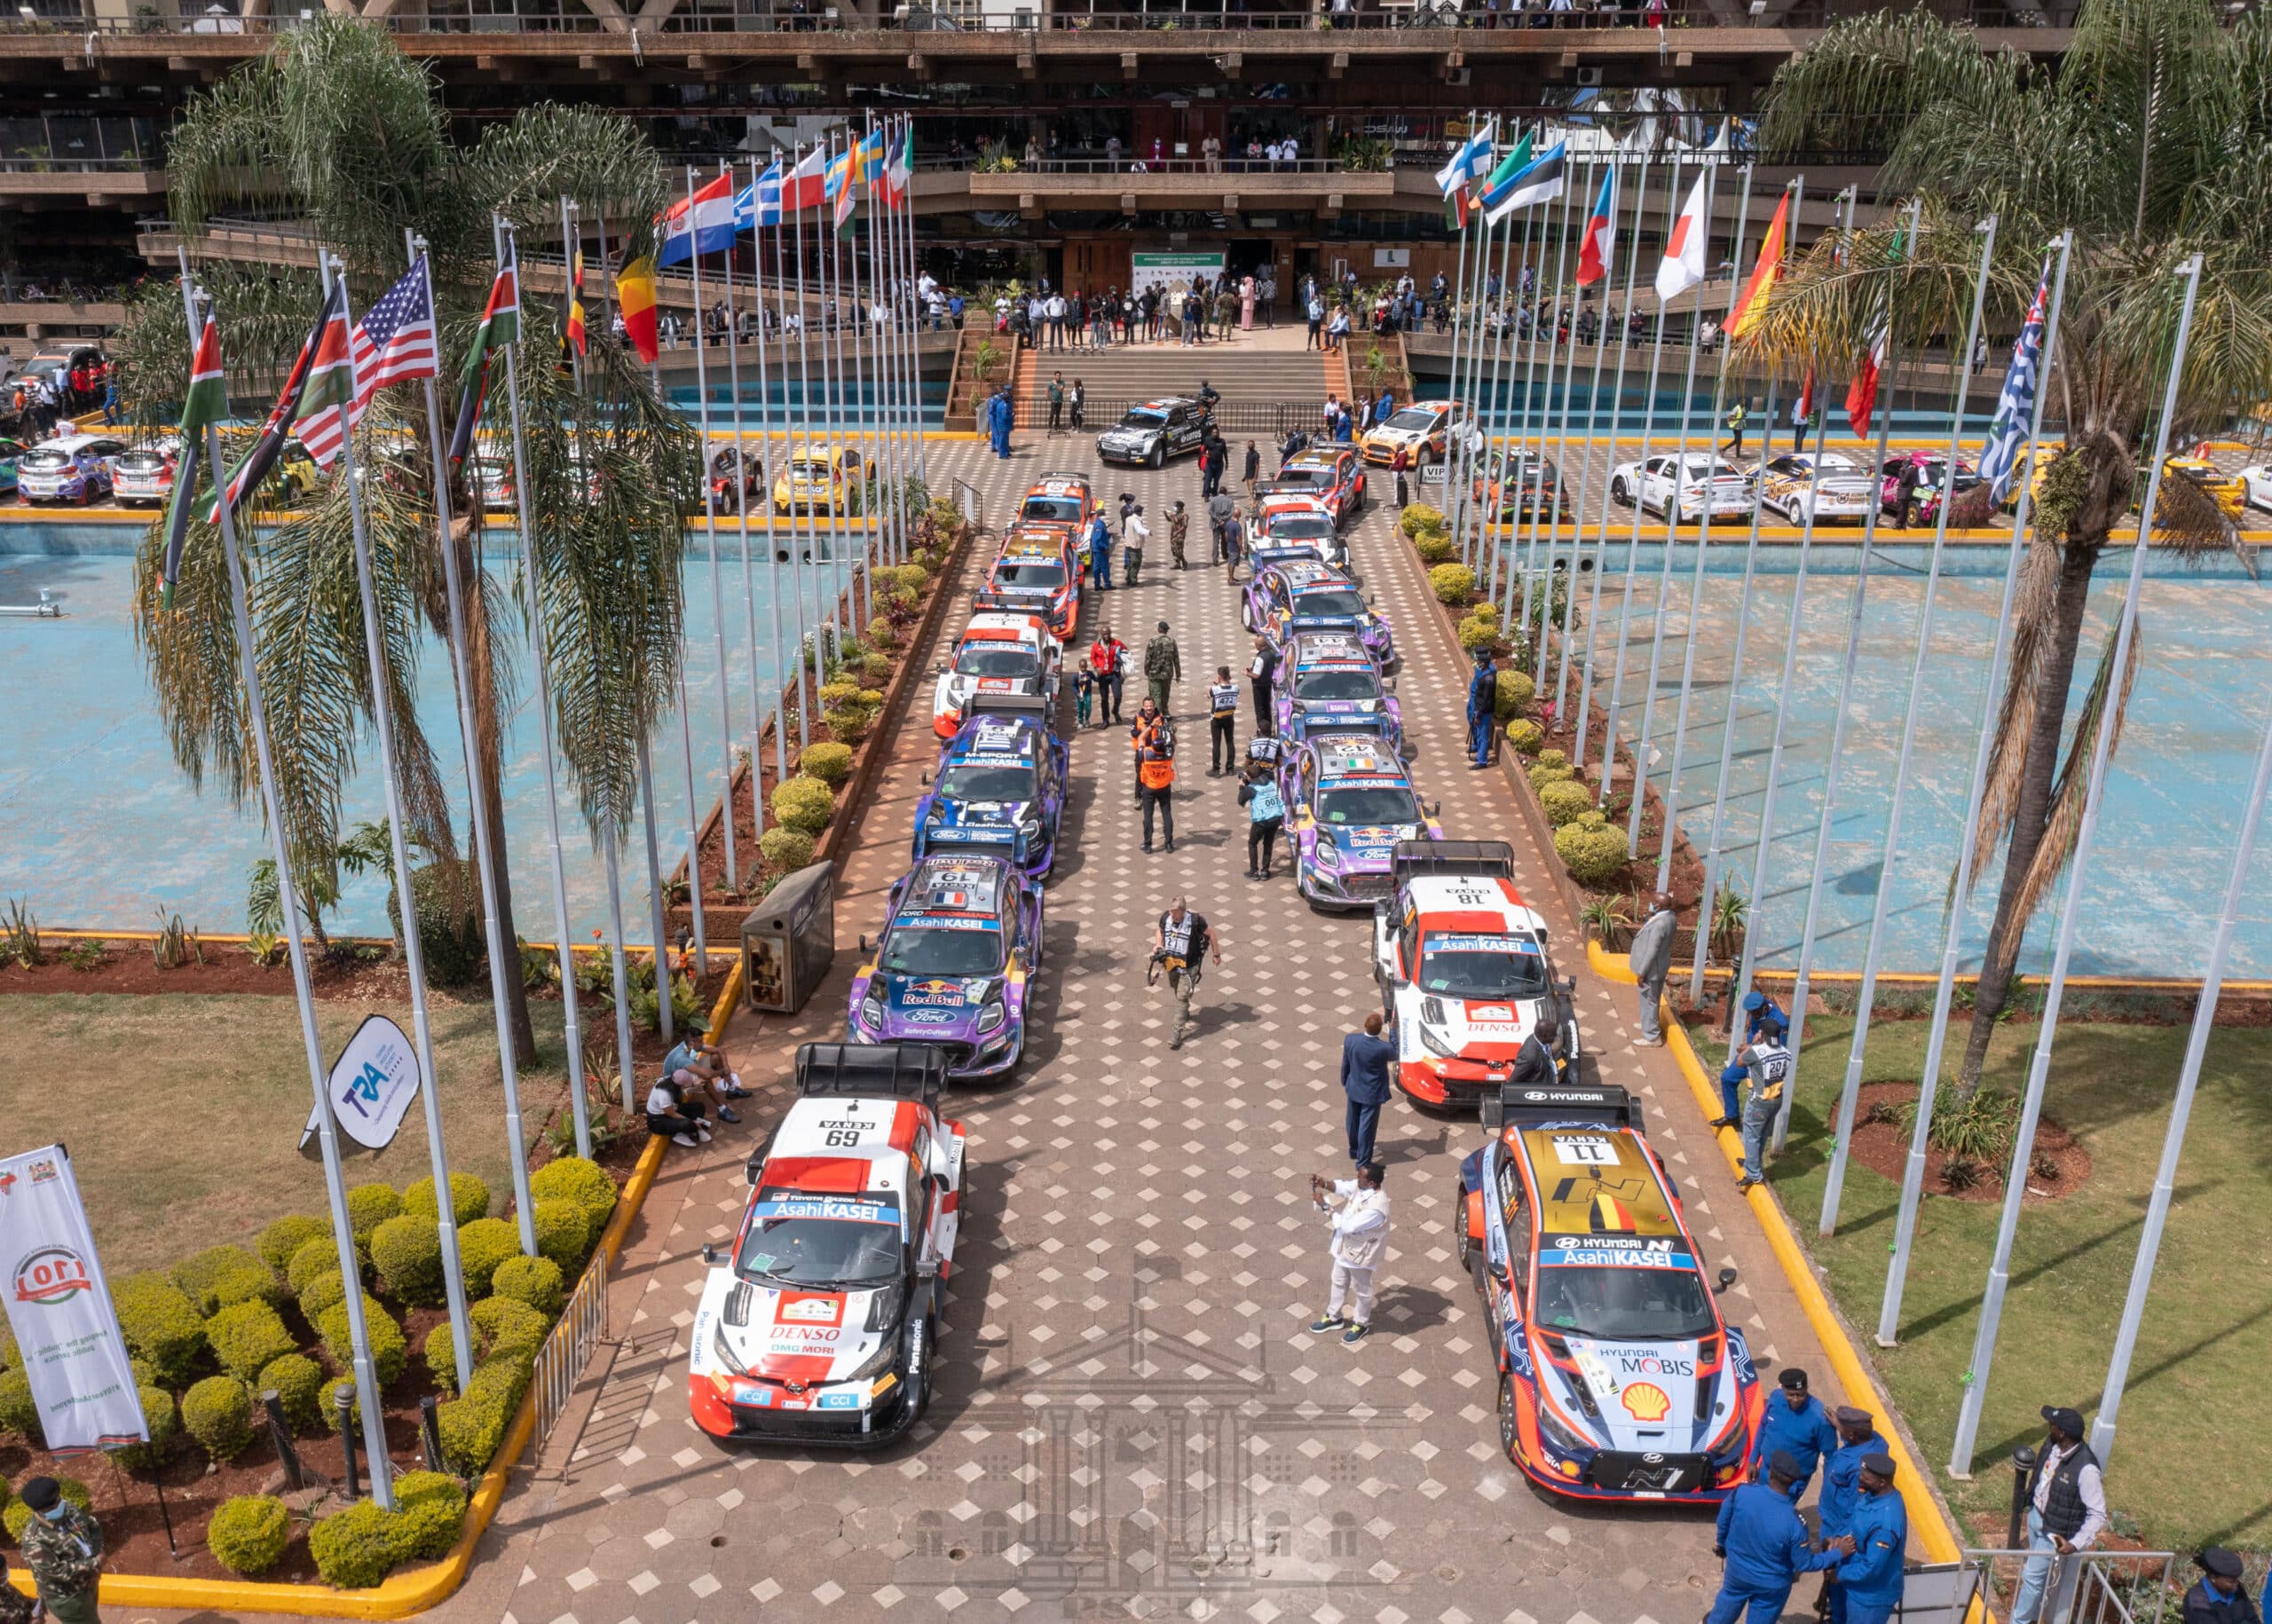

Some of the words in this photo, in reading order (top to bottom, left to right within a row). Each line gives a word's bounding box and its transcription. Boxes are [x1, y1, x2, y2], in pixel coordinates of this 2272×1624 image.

[1427, 468, 1445, 477] VIP
[1351, 838, 1376, 847] Red
[942, 872, 972, 882] 19
[1458, 894, 1485, 904] 18
[924, 910, 996, 919] PERFORMANCE
[910, 918, 982, 929] AsahiKASEI
[1441, 940, 1522, 952] AsahiKASEI
[902, 994, 931, 1005] Red
[933, 994, 965, 1007] Bull
[913, 1010, 947, 1022] Ford
[1468, 1022, 1521, 1033] DENSO
[1568, 1020, 1579, 1059] Panasonic
[342, 1061, 390, 1118] TRA
[1550, 1092, 1604, 1101] HYUNDAI
[825, 1130, 860, 1147] 69
[1569, 1144, 1605, 1161] 11
[856, 1198, 887, 1207] Racing
[774, 1202, 879, 1220] AsahiKASEI
[1583, 1238, 1642, 1250] HYUNDAI
[1563, 1250, 1672, 1267] AsahiKASEI
[769, 1326, 840, 1342] DENSO
[770, 1344, 801, 1353] DMG
[801, 1344, 835, 1355] MORI
[909, 1318, 923, 1375] Panasonic
[1599, 1349, 1659, 1358] HYUNDAI
[1621, 1358, 1694, 1376] MOBIS
[743, 1391, 763, 1402] CCI
[830, 1395, 851, 1407] CCI
